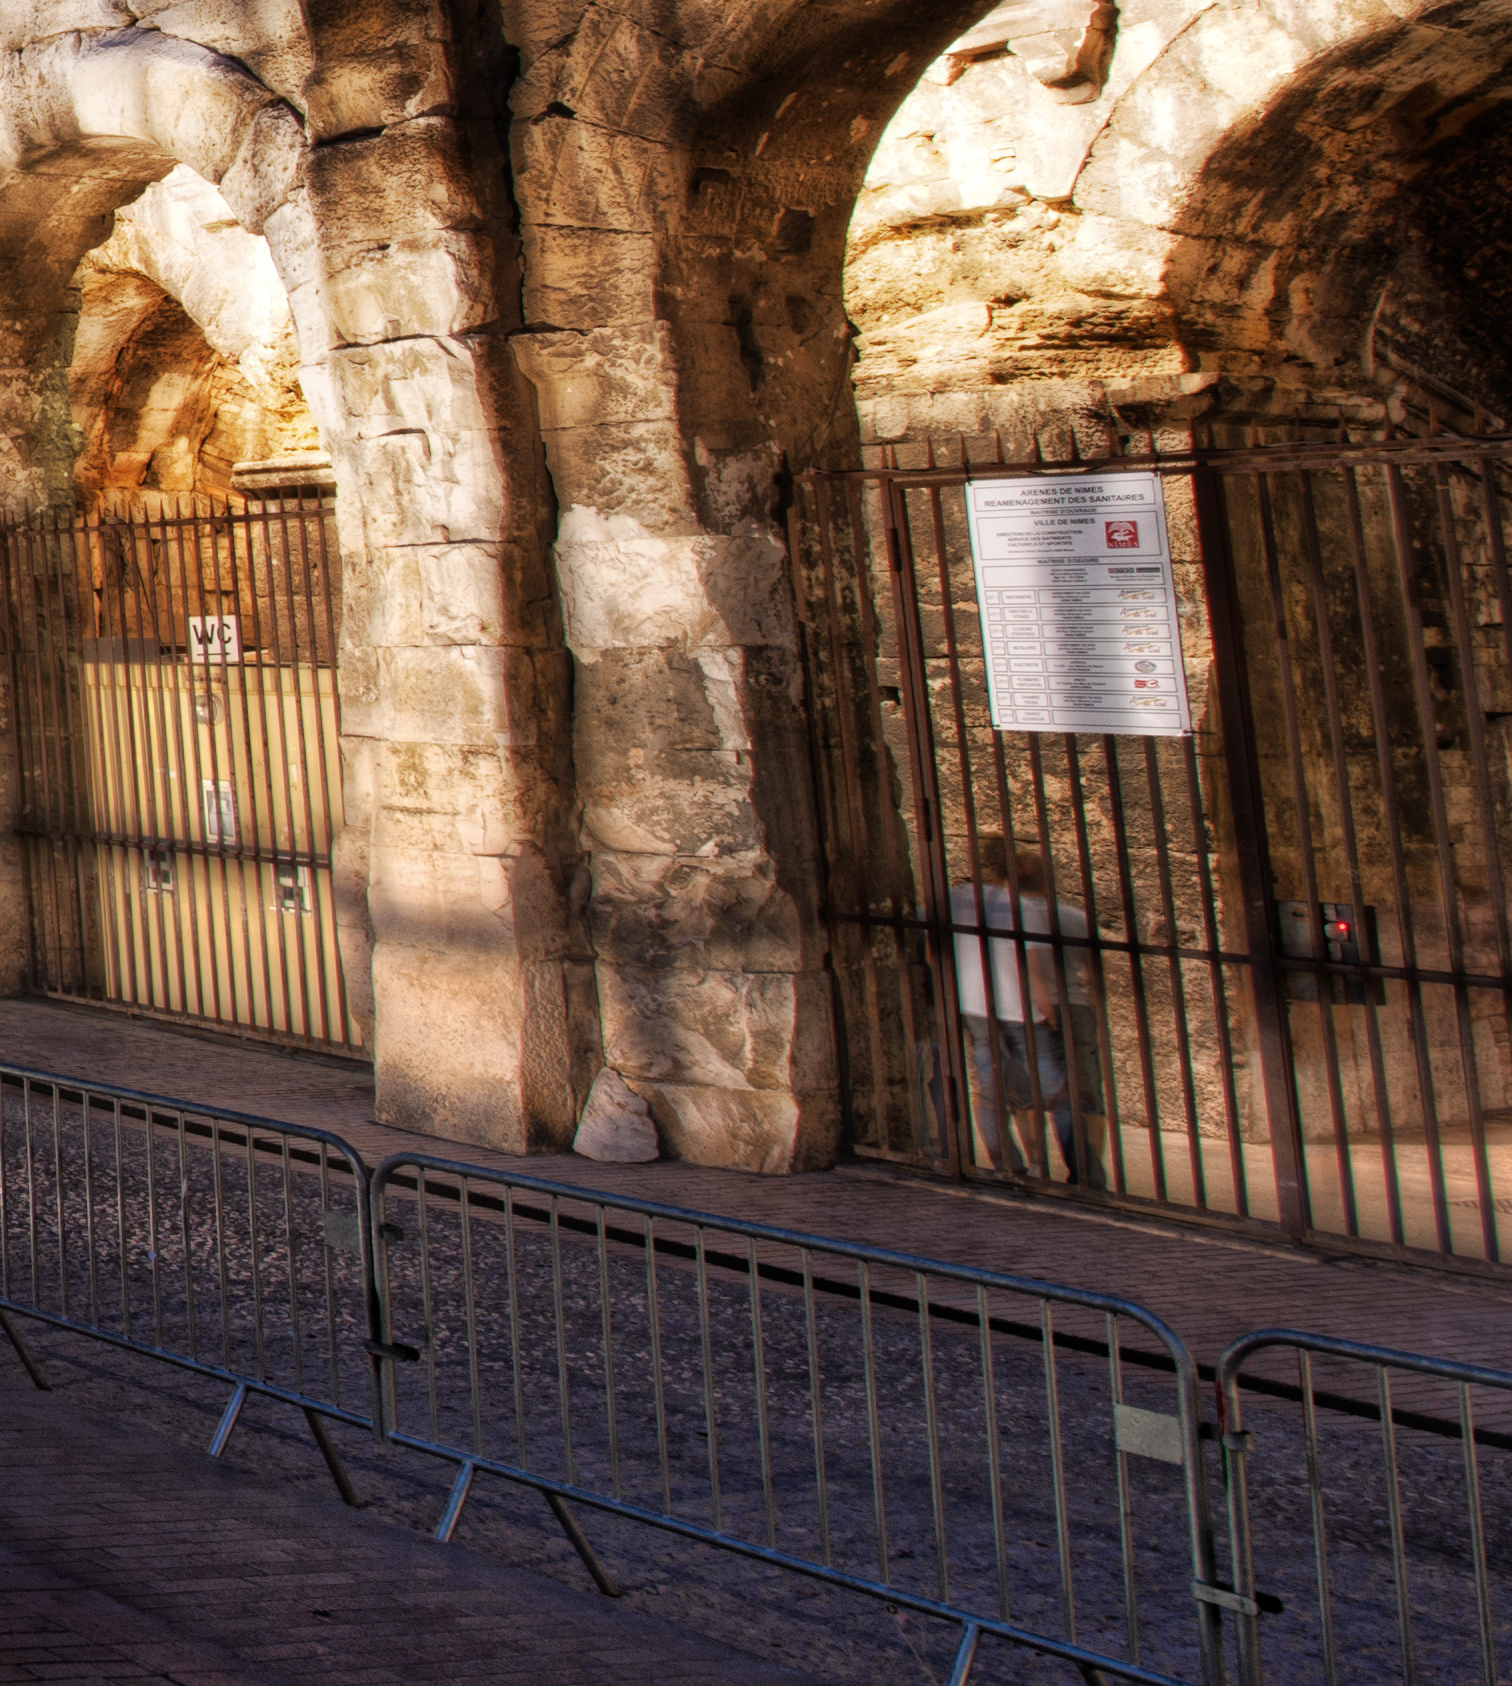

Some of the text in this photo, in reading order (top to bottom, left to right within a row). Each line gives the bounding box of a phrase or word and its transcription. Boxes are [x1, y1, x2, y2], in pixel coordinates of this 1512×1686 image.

[1020, 485, 1104, 497] ARENES DE NIMES
[984, 493, 1145, 507] REAMENAGEMENT DES SANITAIRES
[192, 623, 232, 645] WC
